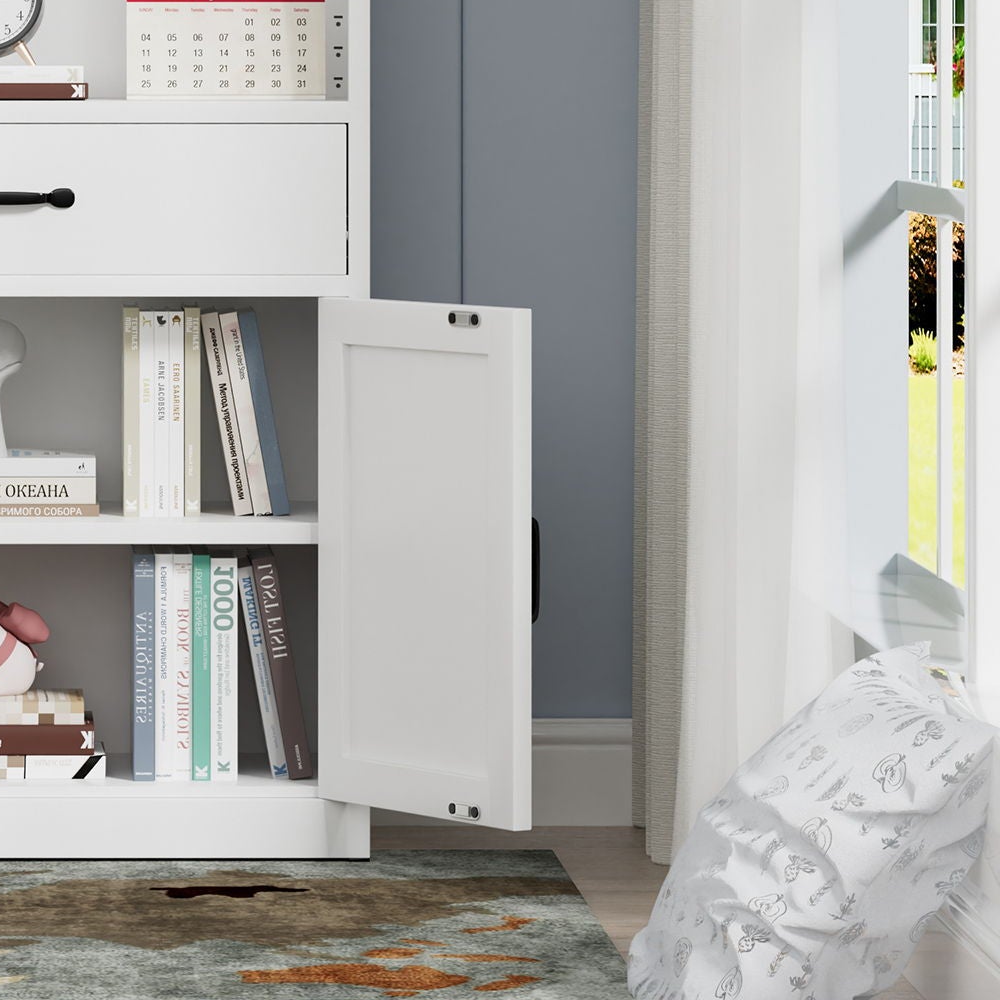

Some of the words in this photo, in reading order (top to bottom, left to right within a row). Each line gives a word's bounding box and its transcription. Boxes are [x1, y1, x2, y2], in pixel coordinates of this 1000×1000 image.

[16, 10, 24, 20] 4
[245, 18, 254, 26] 01
[270, 18, 281, 26] 02
[296, 18, 307, 26] 03
[4, 23, 11, 35] 5
[141, 33, 151, 42] 04
[167, 33, 177, 42] 05
[193, 33, 203, 42] 06
[218, 33, 229, 42] 07
[245, 33, 254, 42] 08
[270, 33, 281, 42] 09
[296, 33, 307, 42] 10
[141, 49, 151, 57] 11
[167, 49, 177, 57] 12
[193, 49, 203, 57] 13
[218, 49, 229, 57] 14
[245, 49, 254, 57] 15
[270, 49, 281, 57] 16
[296, 49, 307, 57] 17
[141, 64, 151, 72] 18
[167, 64, 177, 72] 19
[193, 64, 203, 72] 20
[218, 64, 229, 72] 21
[245, 64, 254, 72] 22
[270, 64, 281, 72] 23
[296, 64, 307, 72] 24
[141, 80, 151, 88] 25
[167, 80, 177, 88] 26
[193, 80, 203, 88] 27
[218, 80, 229, 88] 28
[245, 80, 254, 88] 29
[270, 80, 281, 88] 30
[296, 80, 307, 88] 31
[209, 327, 218, 347] ДЖЕФФ
[219, 383, 230, 408] Метод
[230, 458, 244, 500] проектами
[5, 484, 69, 498] ОКЕАНА
[44, 507, 83, 516] СОБОРА
